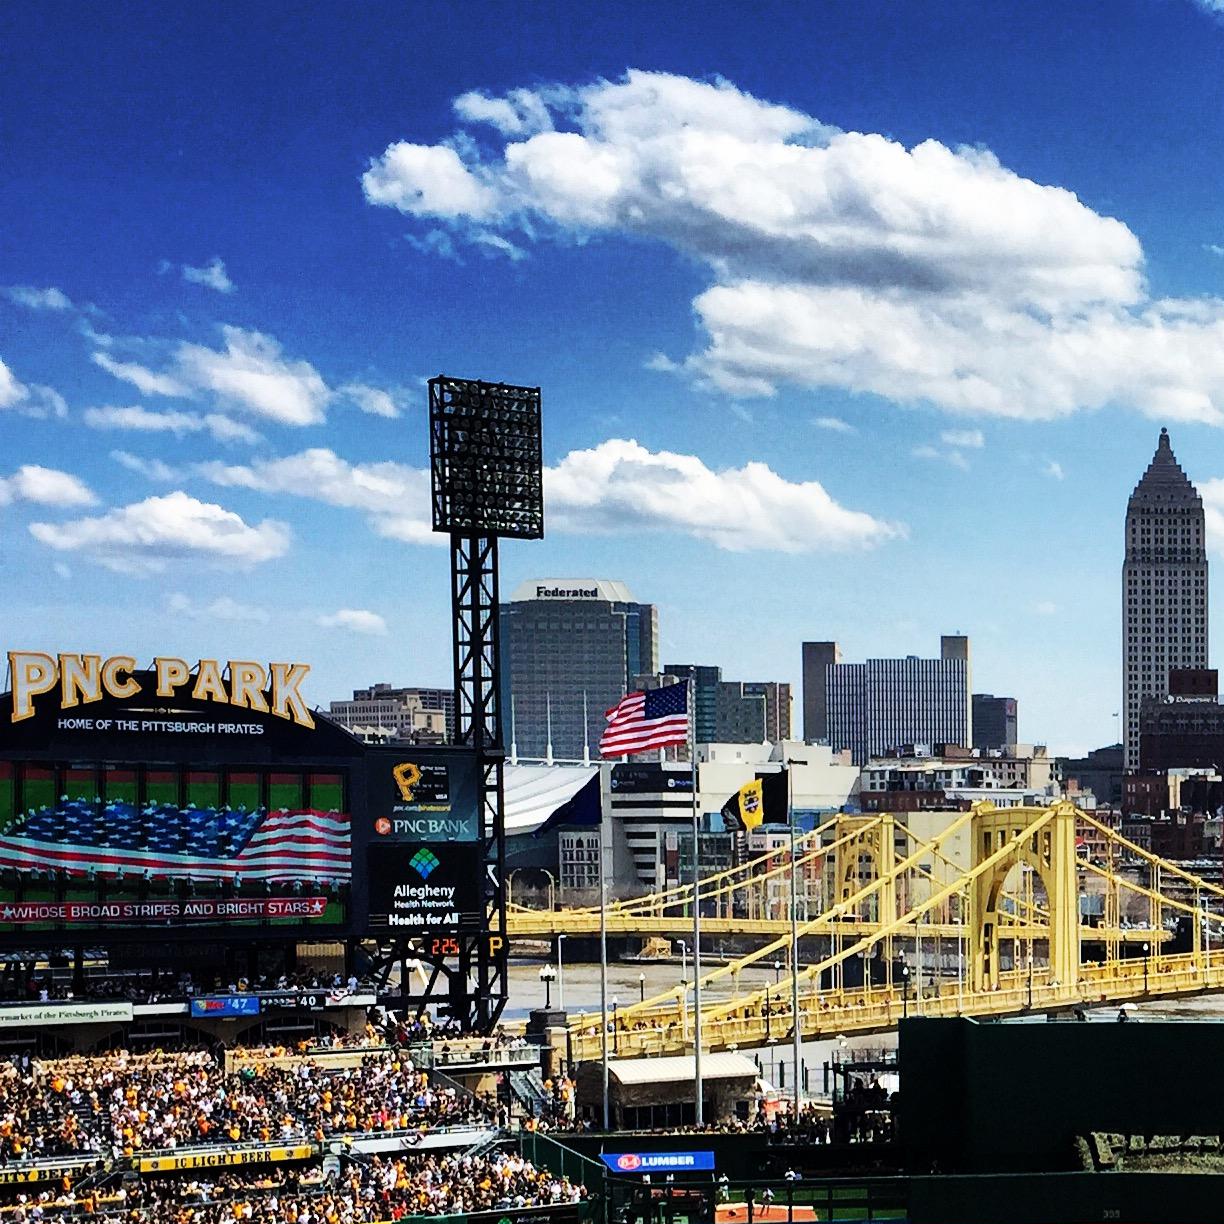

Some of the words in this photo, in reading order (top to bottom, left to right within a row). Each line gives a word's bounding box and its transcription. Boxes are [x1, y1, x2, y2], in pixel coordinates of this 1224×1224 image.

[536, 586, 599, 599] Federated
[7, 651, 143, 723] PNC
[154, 656, 316, 730] PARK
[57, 718, 94, 731] HOME
[96, 719, 111, 731] OF
[115, 720, 139, 732] THE
[142, 721, 215, 734] PITTSBURGH
[218, 723, 265, 735] PIRATES
[393, 819, 426, 833] PNC
[428, 819, 470, 833] BANK
[394, 884, 456, 899] Allegheny
[13, 906, 67, 918] WHOSE
[71, 905, 120, 917] BROAD
[123, 904, 180, 916] STRIPES
[184, 903, 214, 915] AND
[217, 903, 265, 915] BRIGHT
[394, 900, 420, 909] Health
[421, 900, 455, 908] Network
[388, 913, 425, 926] Health
[426, 913, 443, 925] for
[443, 912, 459, 924] All
[489, 936, 503, 957] P
[34, 1012, 43, 1020] of
[44, 1011, 57, 1019] the
[58, 1010, 99, 1019] Pittsburgh
[192, 1154, 237, 1167] LIGHT
[241, 1152, 272, 1163] BEER
[642, 1155, 695, 1168] LUMBER
